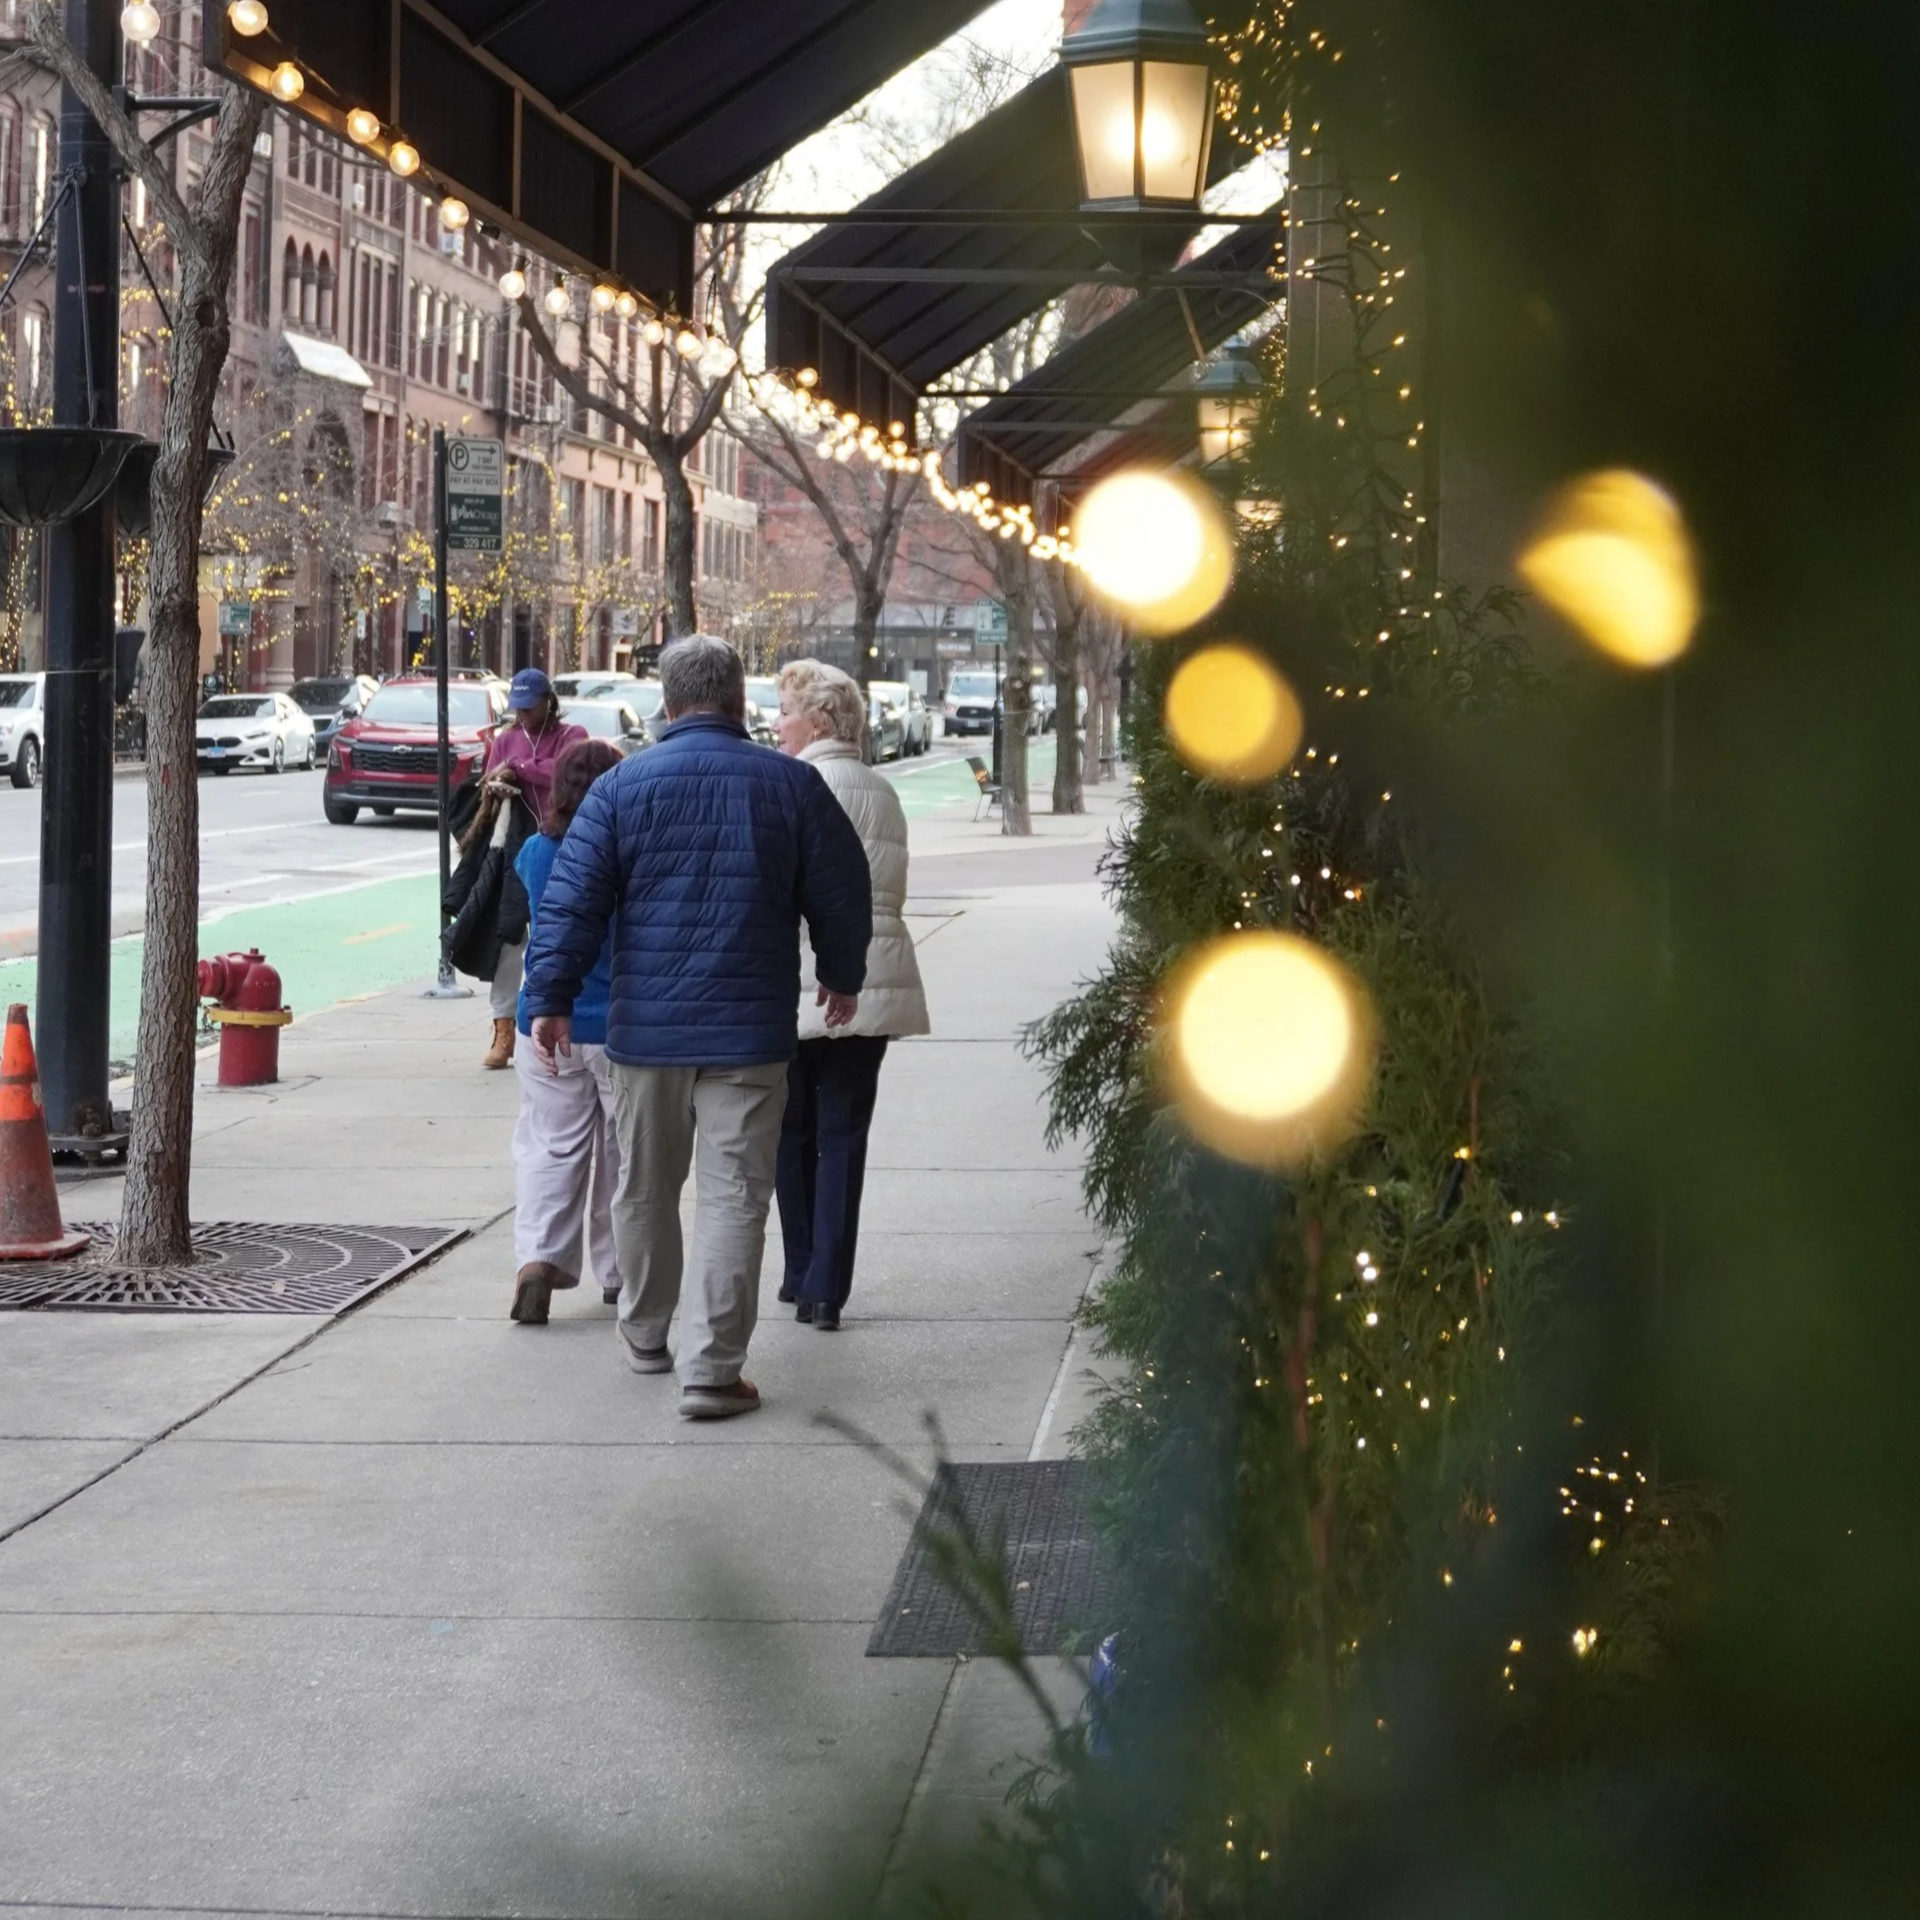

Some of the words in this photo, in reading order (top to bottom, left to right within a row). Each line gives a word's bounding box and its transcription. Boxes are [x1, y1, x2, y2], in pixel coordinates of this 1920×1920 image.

[455, 447, 465, 465] P
[482, 456, 492, 464] DAY
[450, 475, 461, 483] PAY
[472, 477, 483, 485] PAY
[485, 478, 498, 486] BOX
[458, 508, 500, 522] ParkChicago
[464, 537, 480, 548] 329
[481, 538, 496, 549] 417
